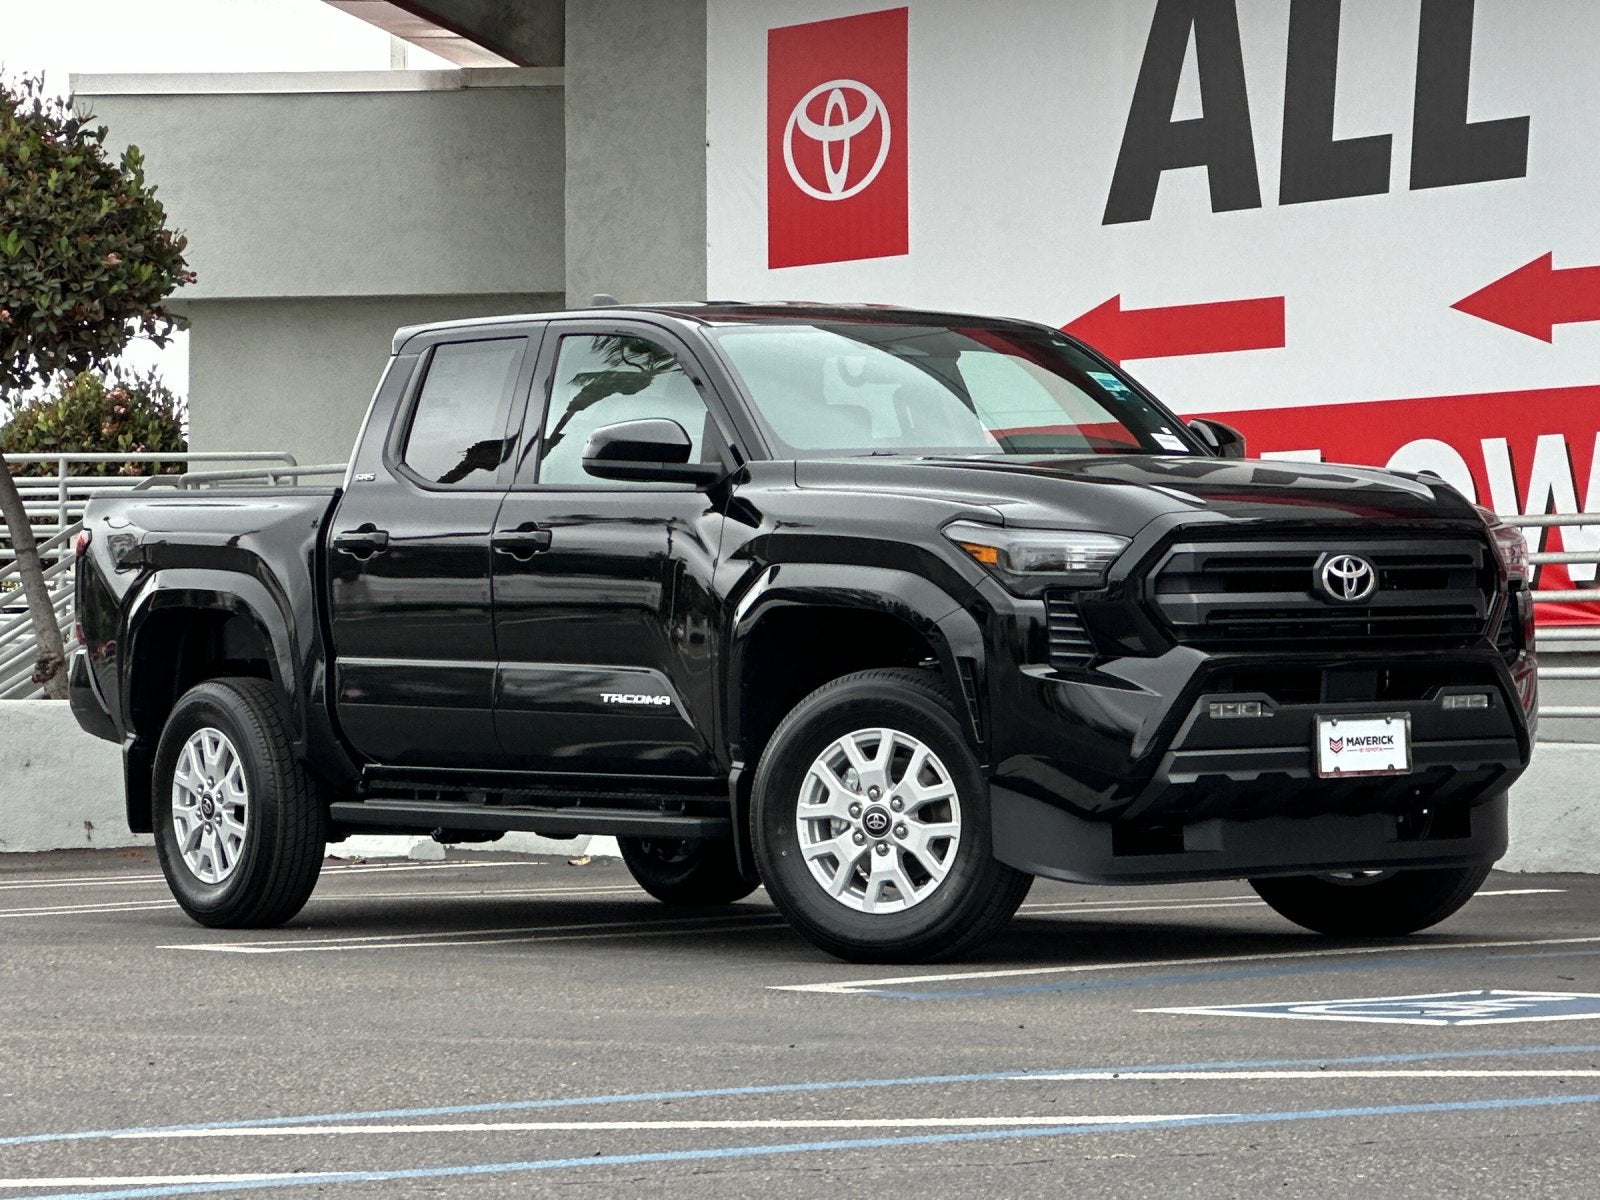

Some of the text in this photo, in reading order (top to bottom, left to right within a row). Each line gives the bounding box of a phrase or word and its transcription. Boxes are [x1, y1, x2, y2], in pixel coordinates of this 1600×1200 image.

[1101, 0, 1530, 225] ALL
[600, 693, 671, 705] TACOMA
[1346, 735, 1394, 746] MAVERICK
